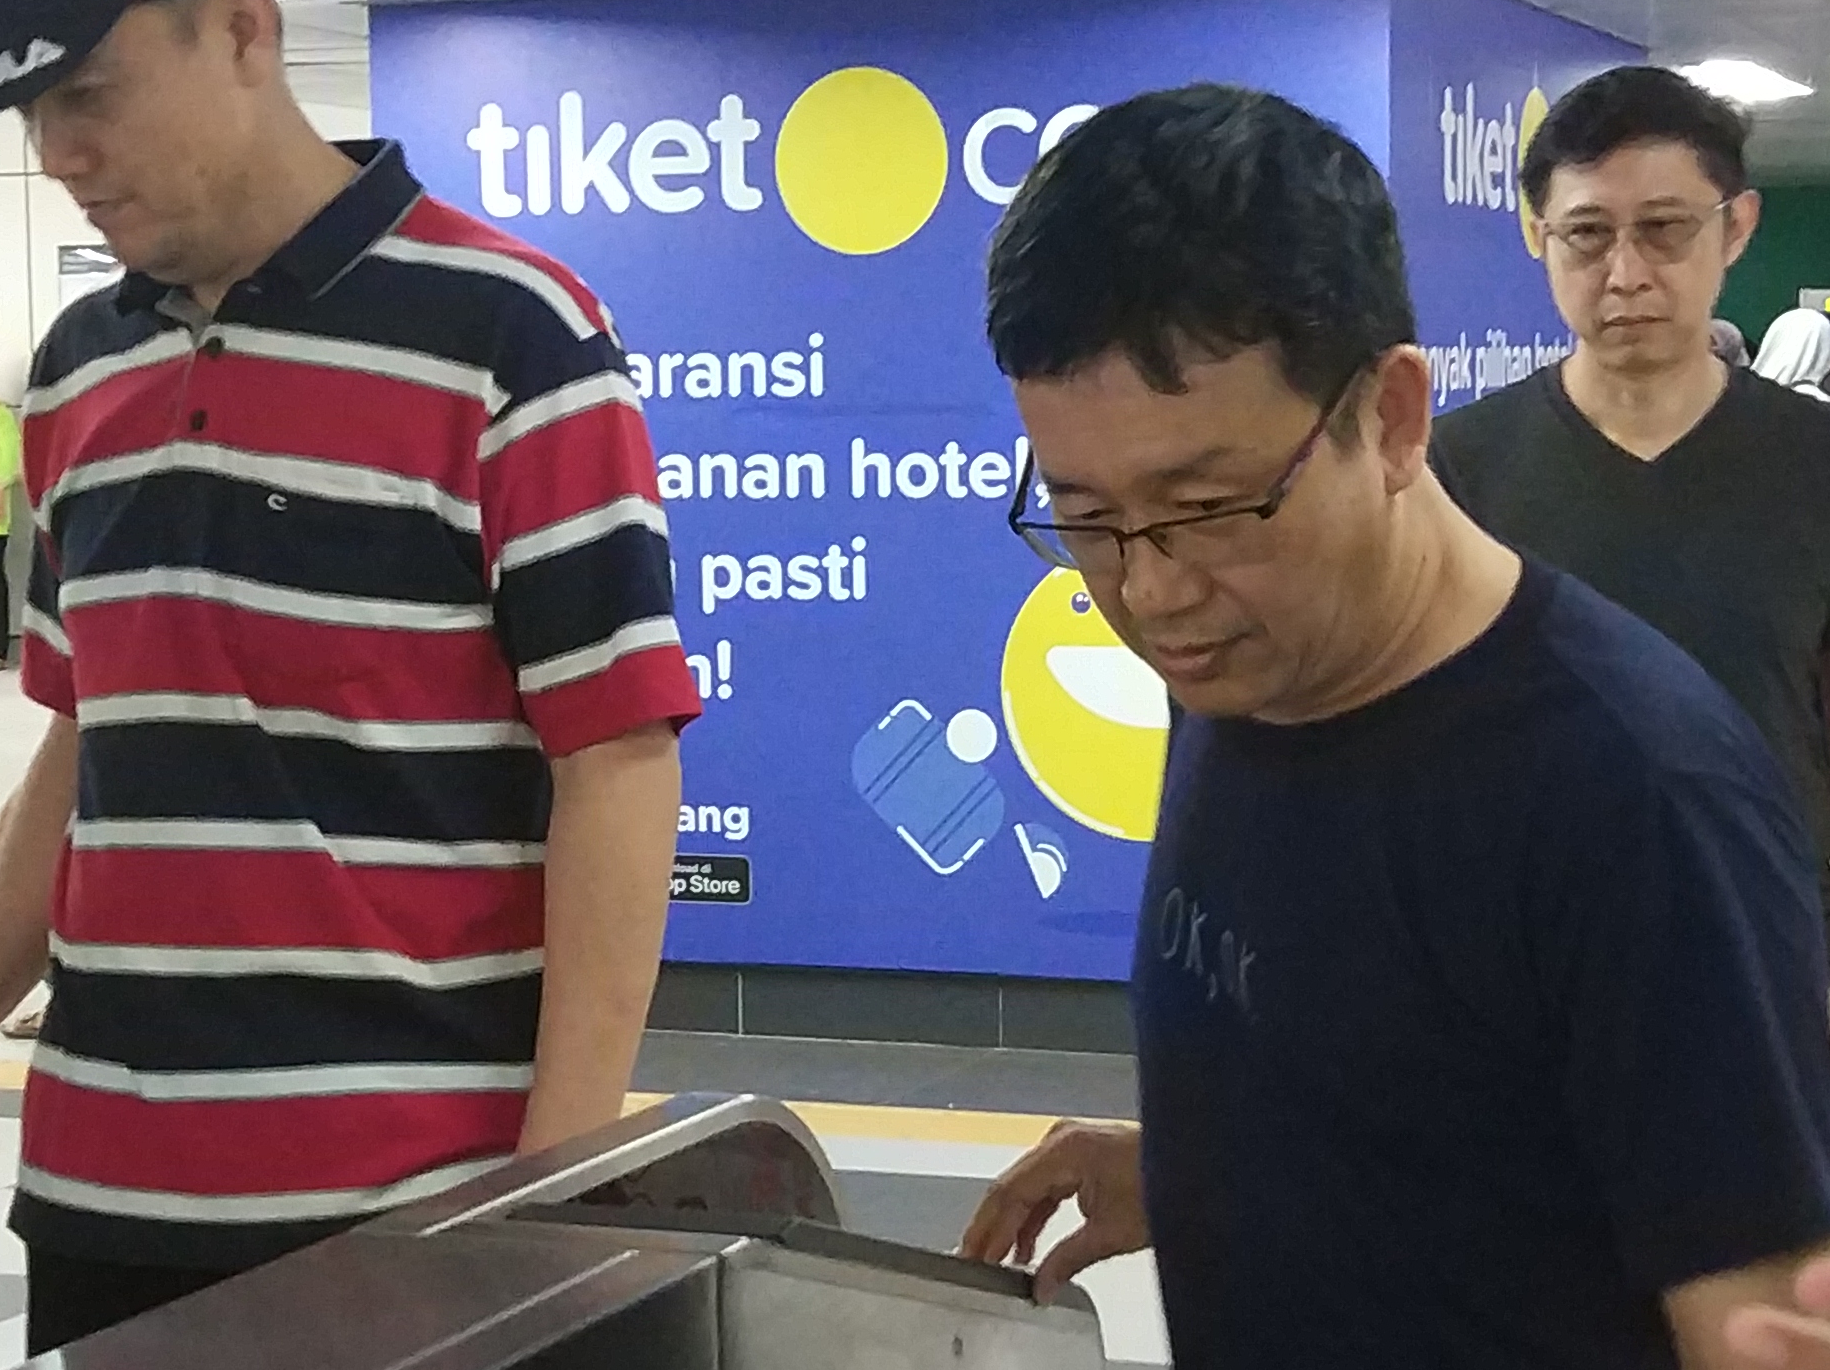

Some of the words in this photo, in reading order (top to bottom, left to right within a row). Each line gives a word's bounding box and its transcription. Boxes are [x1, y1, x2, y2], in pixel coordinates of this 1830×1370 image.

[466, 89, 764, 218] tiket
[1439, 81, 1517, 213] tiket
[1421, 330, 1473, 408] nyak
[700, 535, 868, 614] pasti
[689, 874, 742, 895] Store
